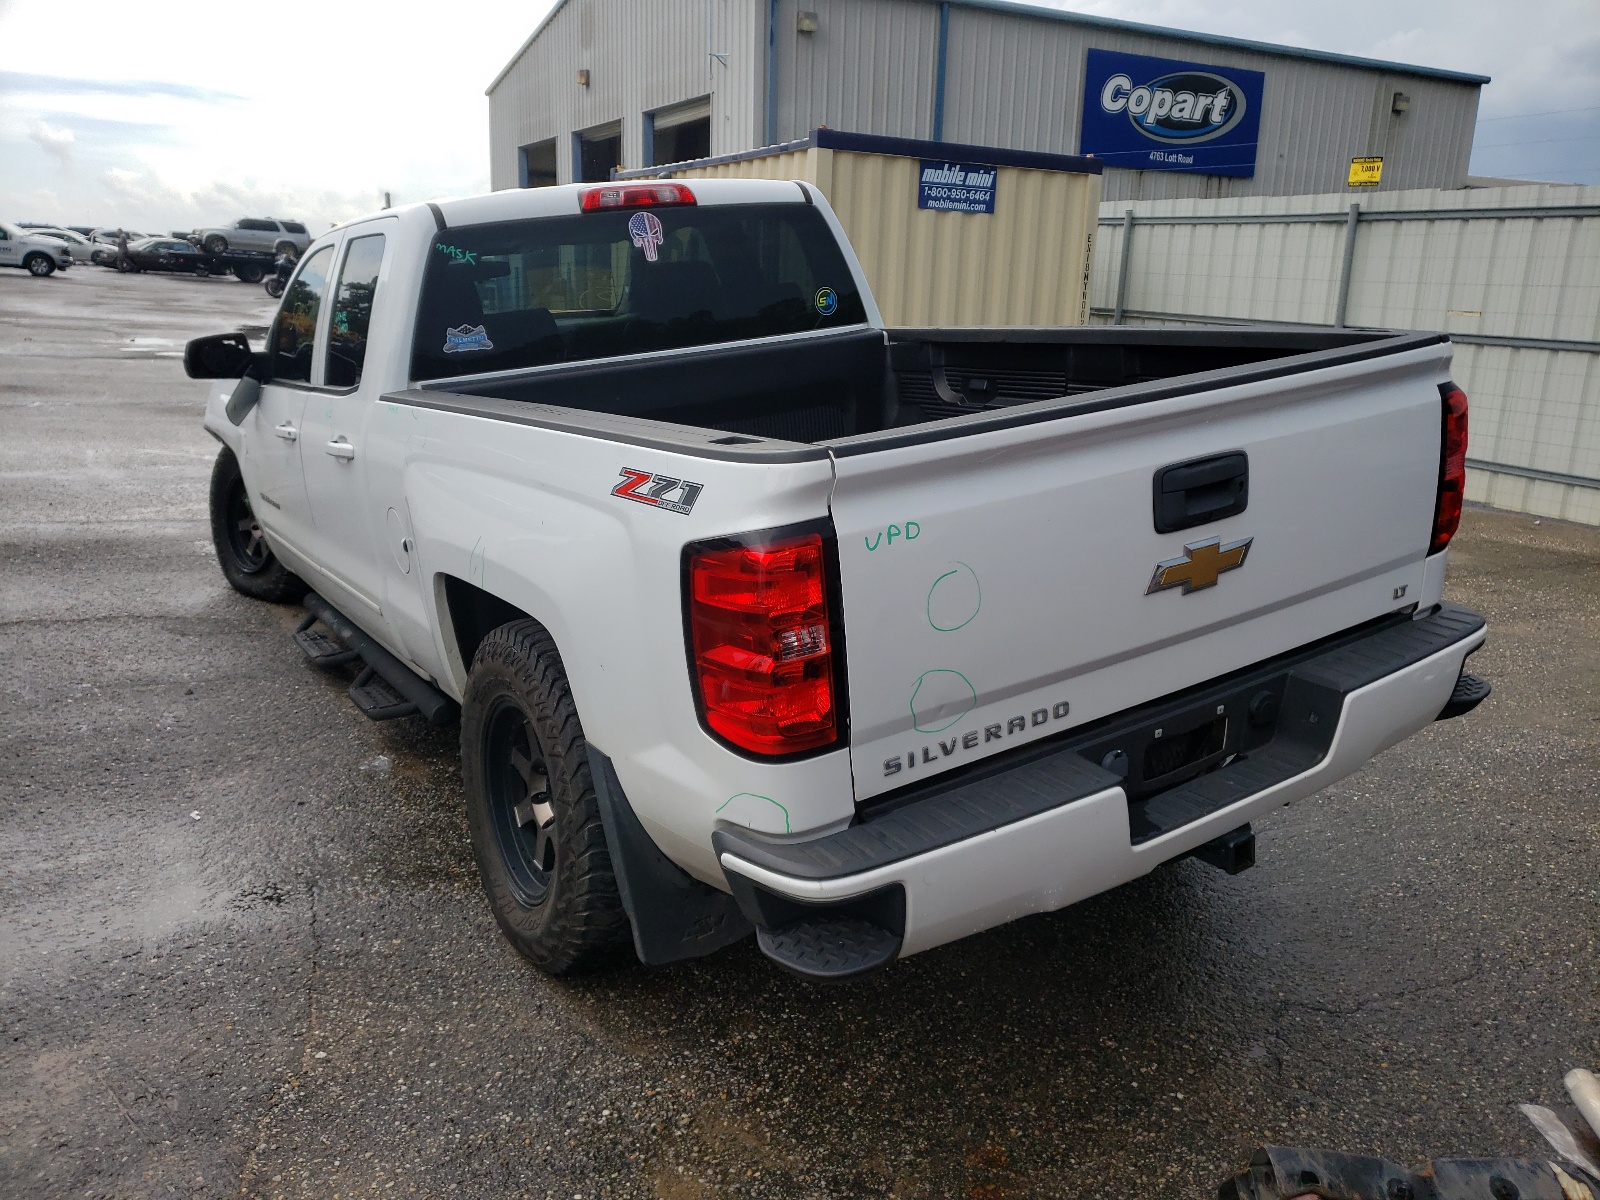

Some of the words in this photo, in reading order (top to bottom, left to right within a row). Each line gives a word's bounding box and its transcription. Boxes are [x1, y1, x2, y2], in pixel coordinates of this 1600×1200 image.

[1101, 74, 1230, 125] Copart
[1149, 151, 1164, 161] 4763
[1164, 153, 1177, 162] Lott
[1178, 154, 1194, 164] Road
[922, 164, 965, 185] mobile
[965, 170, 994, 187] mini
[924, 187, 991, 201] 1-800-950-6464
[927, 200, 987, 212] mobilemini.com
[610, 467, 704, 514] Z71
[883, 700, 1070, 777] SILVERADO
